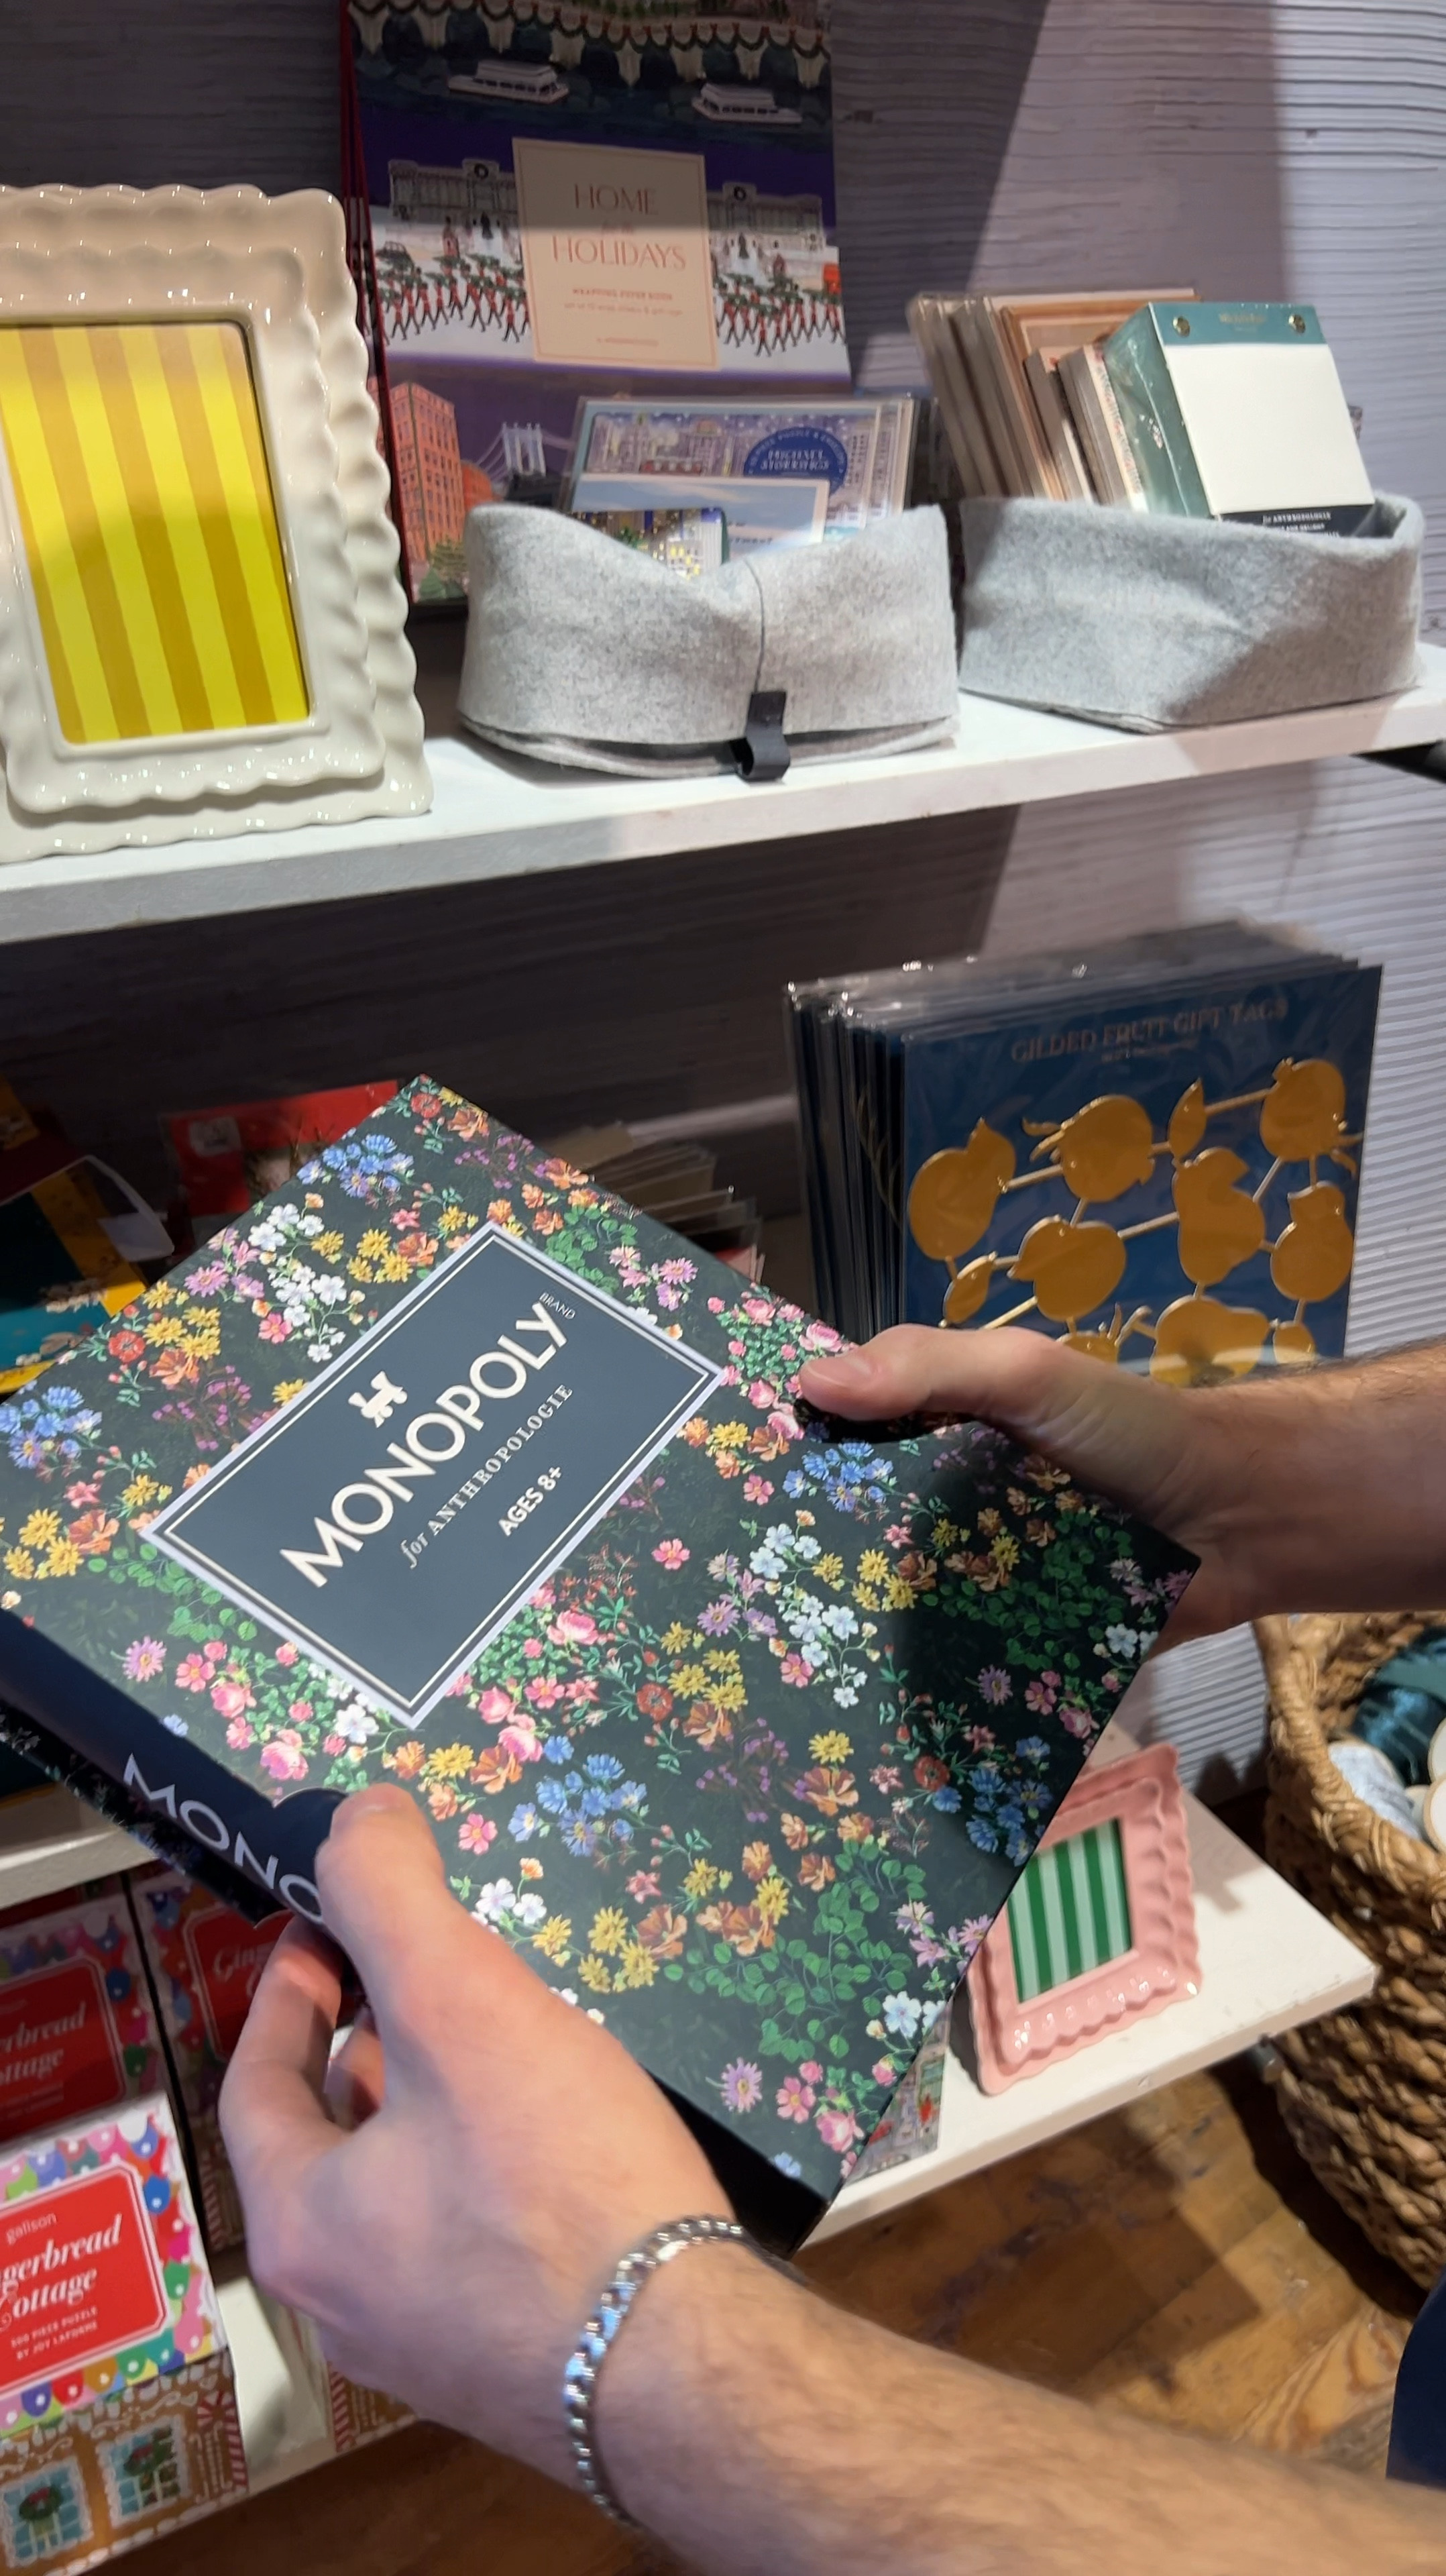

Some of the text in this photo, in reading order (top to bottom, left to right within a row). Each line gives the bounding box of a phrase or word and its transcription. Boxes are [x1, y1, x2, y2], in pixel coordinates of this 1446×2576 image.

[575, 183, 659, 215] HOME
[552, 235, 686, 269] HOLIDAYS
[1011, 1029, 1097, 1063] GILDED
[1174, 1006, 1221, 1033] GIFT
[1229, 998, 1288, 1024] TAGS
[539, 1292, 576, 1320] BRAND
[280, 1301, 567, 1588] MONOPOLY
[400, 1384, 573, 1570] for ANTHROPOLOGIE
[498, 1466, 562, 1537] AGES 8+
[6, 2212, 57, 2245] galison
[0, 2213, 122, 2302] gerbread
[32, 2320, 58, 2340] PIECE
[61, 2306, 98, 2328] PUZZLE
[16, 2348, 30, 2360] BY
